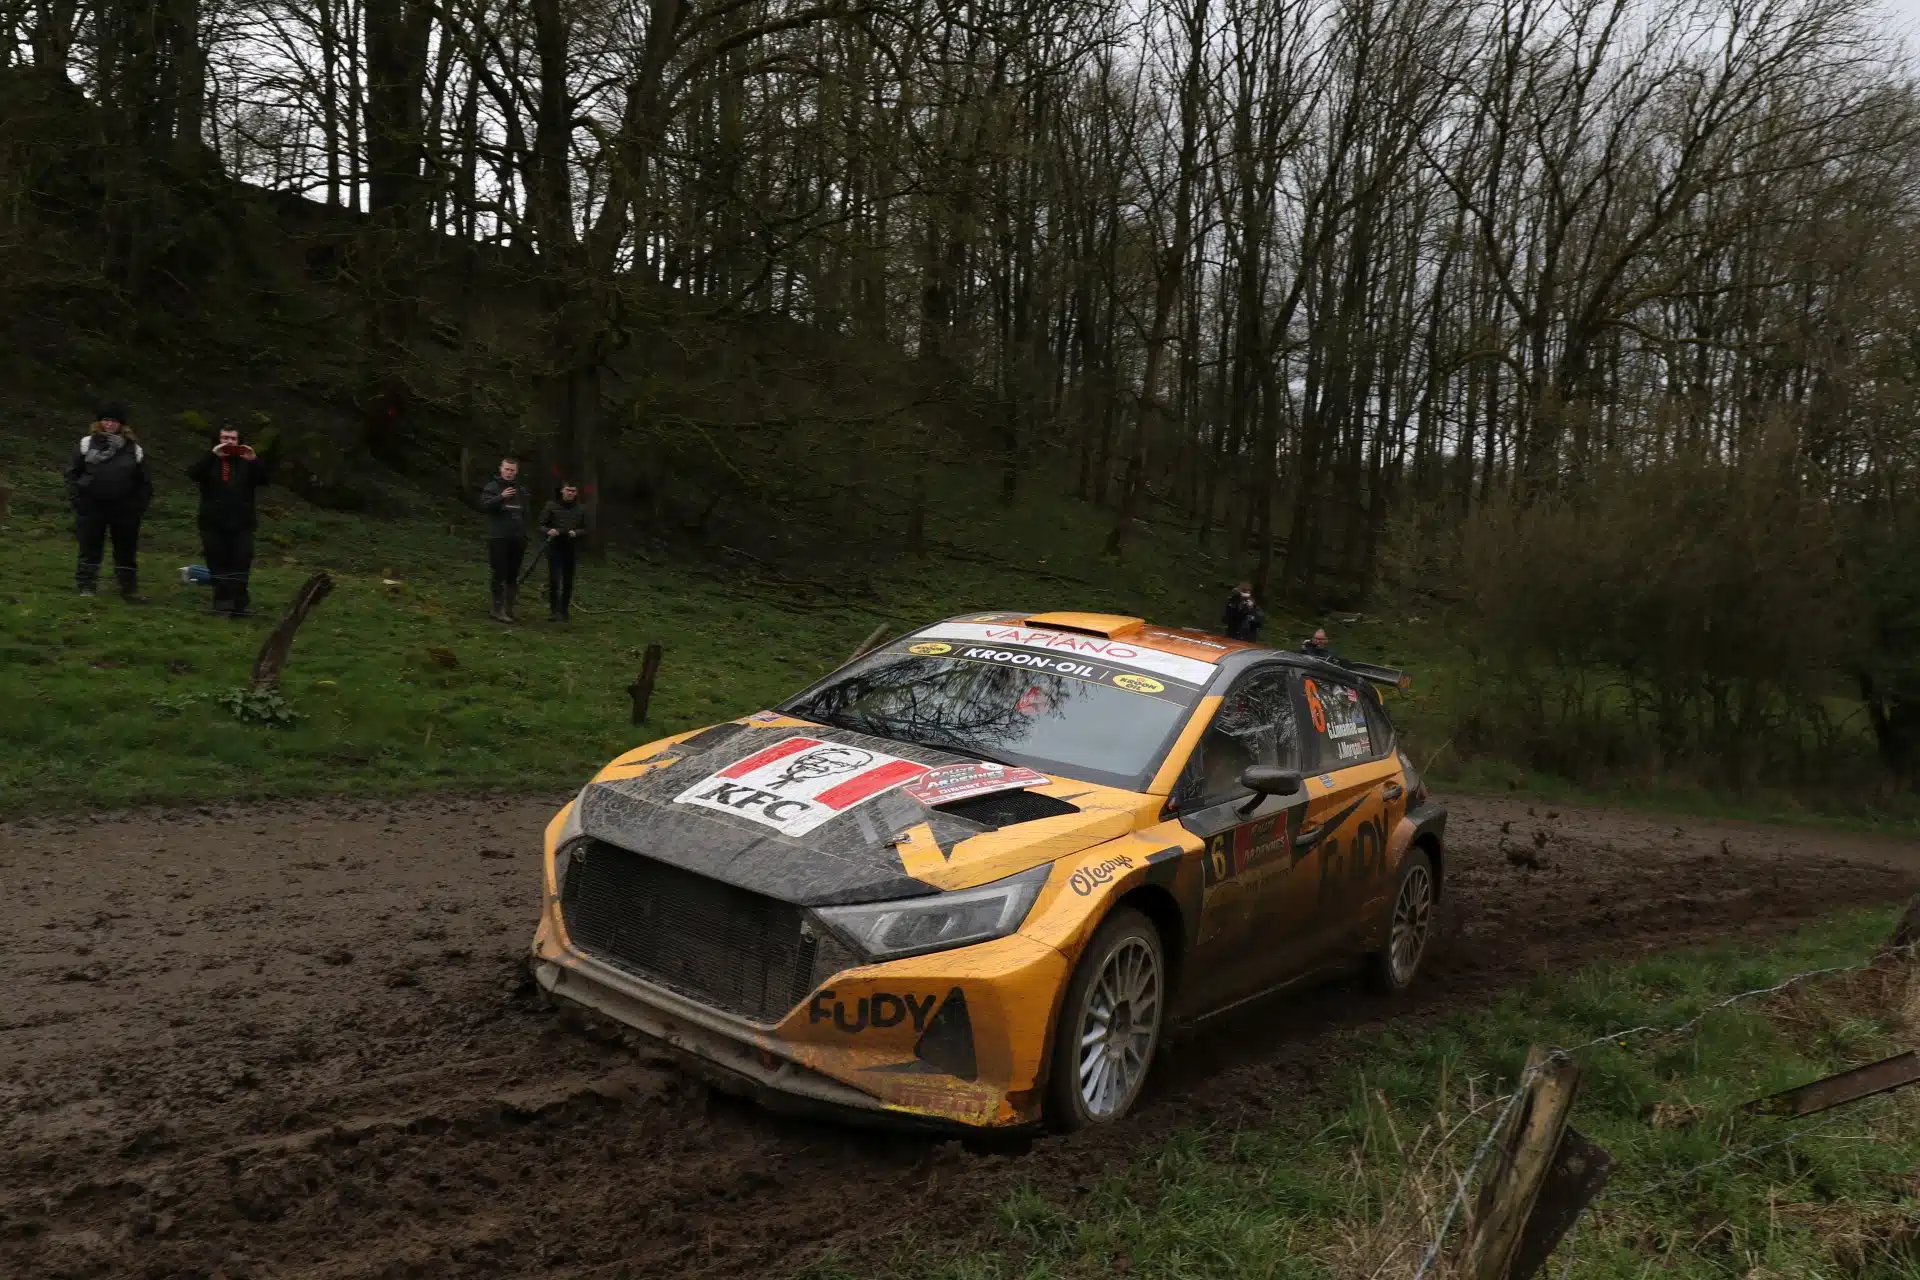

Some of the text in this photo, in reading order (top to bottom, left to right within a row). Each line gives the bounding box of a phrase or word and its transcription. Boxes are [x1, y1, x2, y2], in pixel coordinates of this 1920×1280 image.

[964, 648, 1091, 677] KROON-OIL
[1120, 677, 1157, 690] KROON
[1304, 679, 1326, 733] 6
[926, 770, 1004, 791] ARDENNES
[939, 782, 981, 795] DINANT
[696, 783, 810, 823] KFC
[1069, 853, 1134, 896] O'Learys
[1211, 834, 1226, 881] 6
[808, 989, 936, 1034] FUDY
